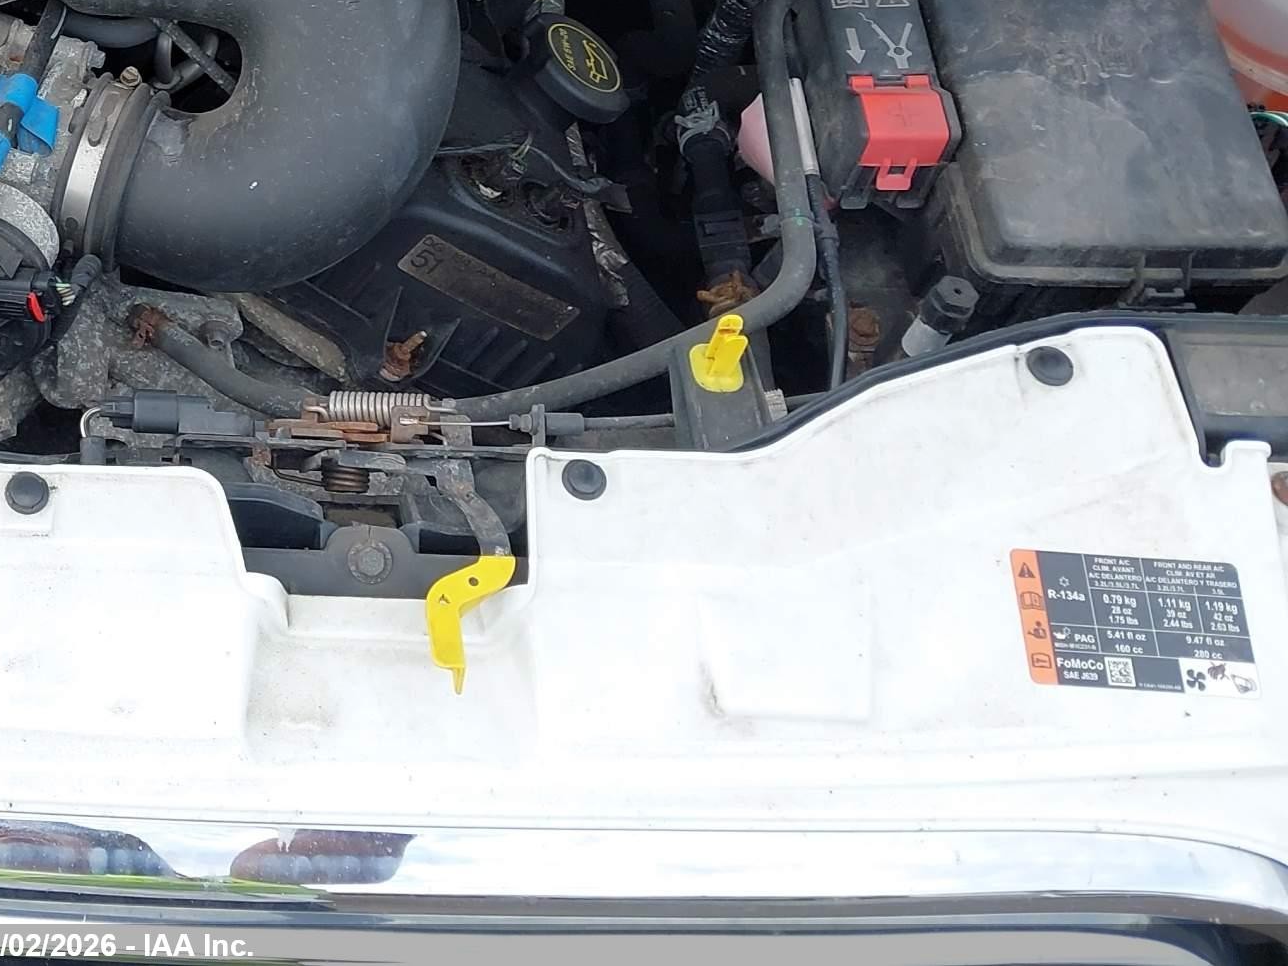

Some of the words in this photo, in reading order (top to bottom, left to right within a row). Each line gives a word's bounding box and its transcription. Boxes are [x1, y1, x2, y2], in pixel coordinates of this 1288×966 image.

[1094, 557, 1117, 565] FRONT
[1154, 561, 1176, 569] FRONT
[1178, 562, 1192, 570] AND
[1102, 573, 1142, 582] DELANTERO
[1158, 576, 1198, 586] DELANTERO
[1206, 580, 1238, 588] TRASERO
[1047, 588, 1086, 602] R-134a
[1102, 594, 1122, 604] 0.79
[1124, 595, 1136, 608] kg
[1158, 598, 1176, 608] 1.11
[1178, 598, 1192, 612] kg
[1111, 606, 1122, 614] 28
[1205, 600, 1224, 611] 1.19
[1225, 602, 1238, 615] kg
[1166, 609, 1176, 618] 39
[1213, 612, 1222, 620] 42
[1224, 614, 1234, 622] oz
[1109, 616, 1125, 624] 1.75
[1126, 616, 1139, 625] lbs
[1163, 618, 1180, 628] 2.44
[1180, 620, 1193, 628] lbs
[1210, 622, 1226, 631] 2.63
[1228, 624, 1240, 632] lbs
[1074, 634, 1096, 643] PAG
[1106, 630, 1124, 640] 5.41
[1126, 632, 1134, 640] fl
[1185, 636, 1204, 644] 9.47
[1206, 636, 1212, 645] fl
[1214, 638, 1224, 646] oz
[1114, 644, 1130, 653] 160
[1132, 646, 1144, 654] cc
[1194, 650, 1210, 658] 280
[1212, 652, 1223, 660] cc
[1056, 657, 1104, 670] FoMoCo
[1063, 670, 1080, 680] SAE
[1081, 672, 1098, 680] J639
